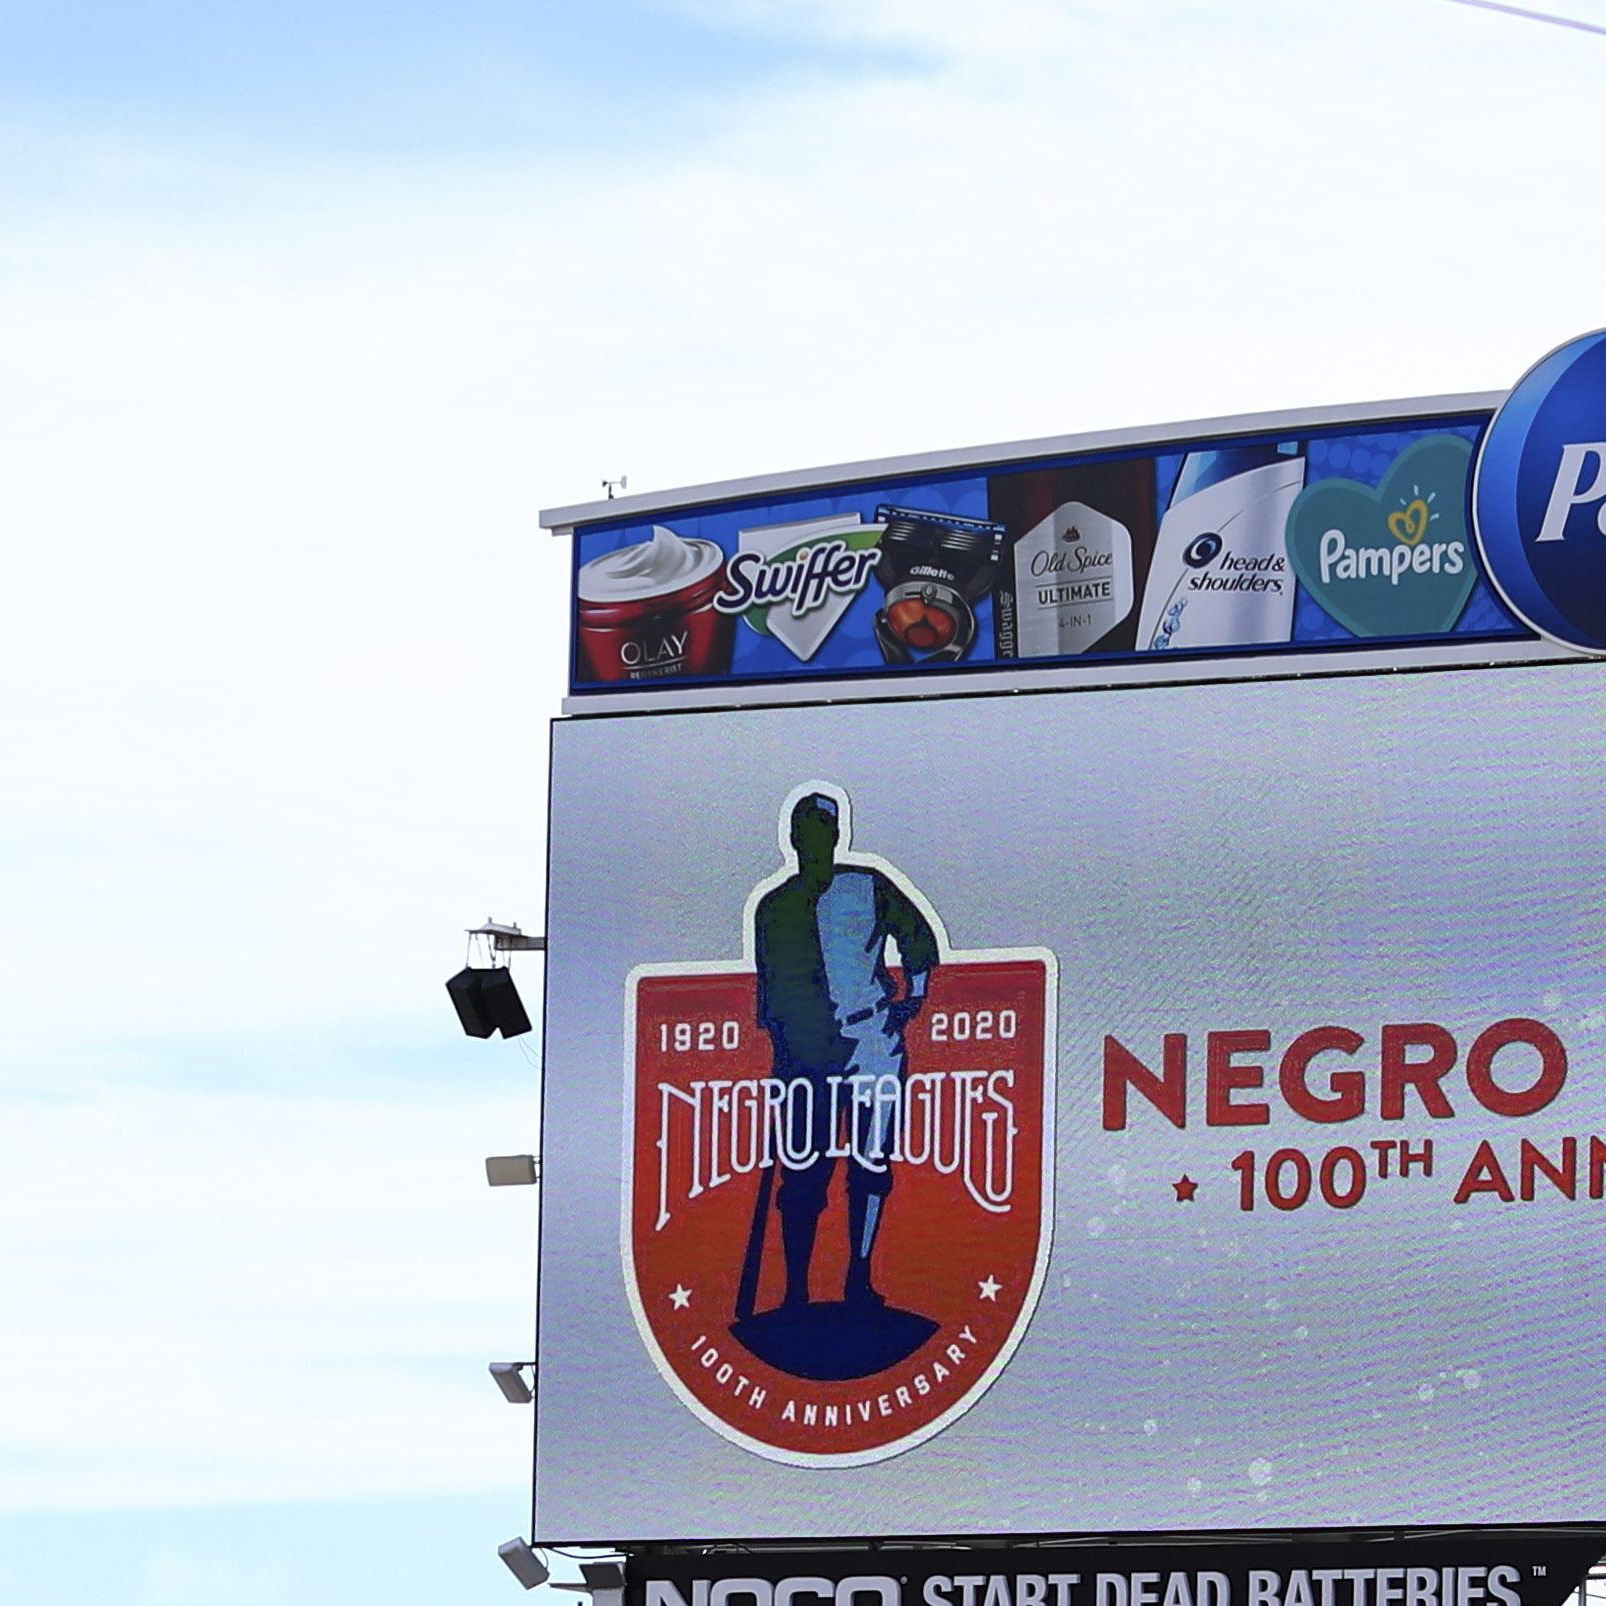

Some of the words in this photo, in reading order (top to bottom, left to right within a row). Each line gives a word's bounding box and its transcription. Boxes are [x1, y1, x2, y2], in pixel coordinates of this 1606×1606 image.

[718, 545, 877, 612] Swiffer
[1030, 550, 1065, 577] Old
[1069, 546, 1113, 576] Spice
[1219, 550, 1275, 572] head
[1319, 528, 1465, 586] Pampers
[1038, 582, 1111, 605] ULTIMATE
[1188, 571, 1285, 597] shoulders
[1058, 614, 1093, 629] 4-IN-1
[621, 630, 688, 665] OLAY
[659, 1021, 740, 1052] 1920
[931, 1009, 1018, 1042] 2020
[1101, 1017, 1568, 1131] NEGRO
[656, 1076, 819, 1232] NEGRO
[826, 1069, 1018, 1213] LEAGUES
[1231, 1138, 1434, 1211] 100TH
[691, 1336, 767, 1410] 100TH
[781, 1326, 979, 1428] ANNIVERSARY
